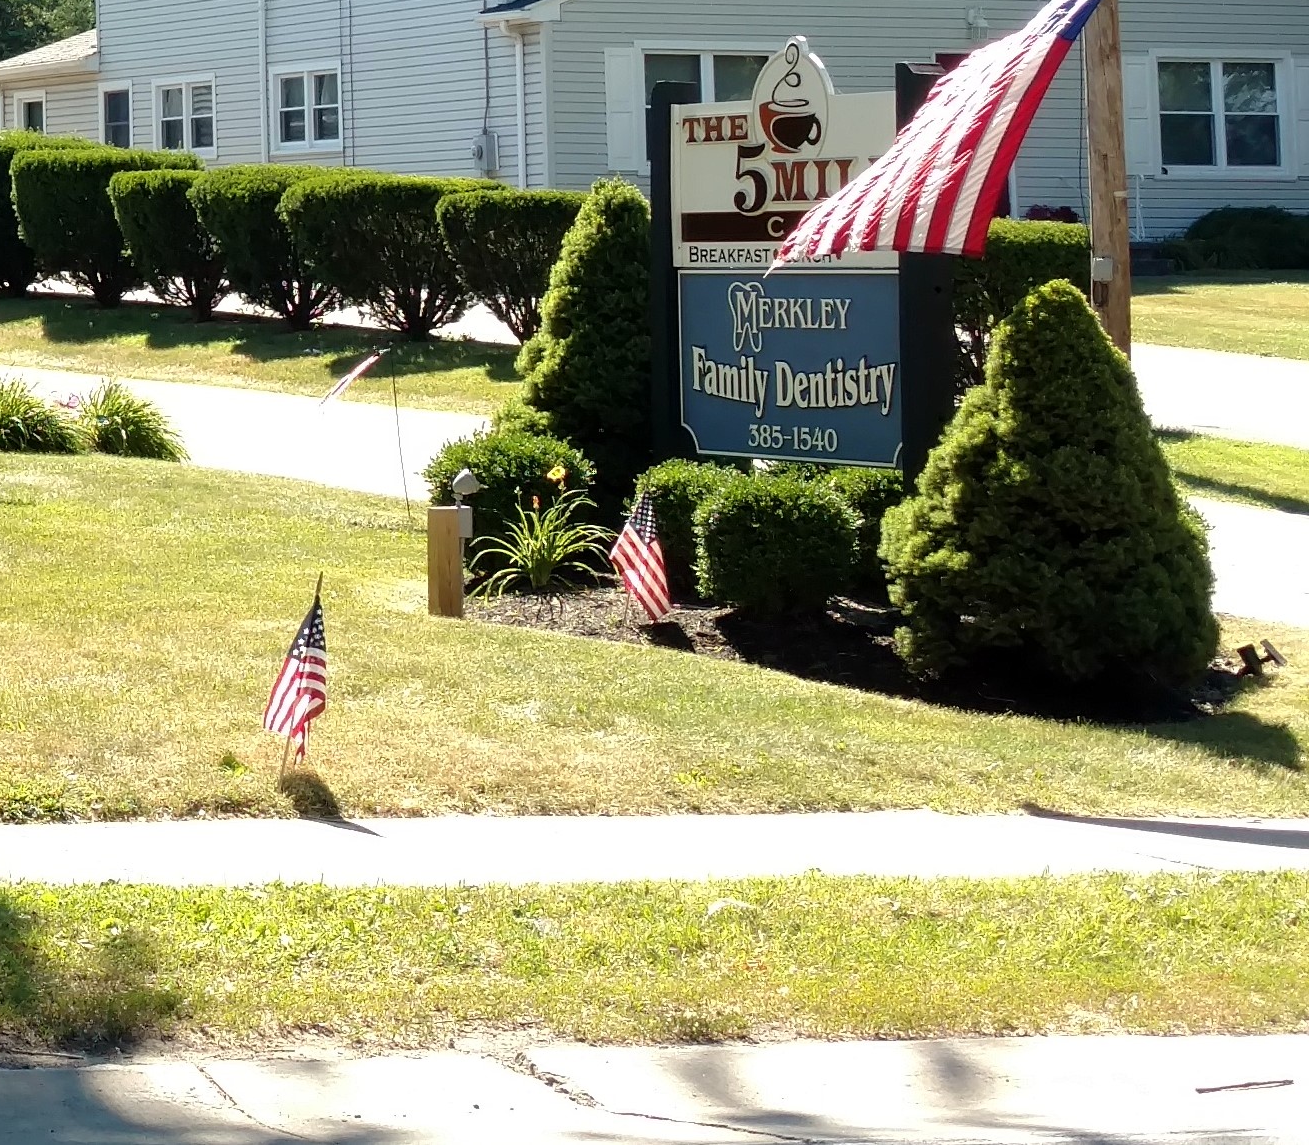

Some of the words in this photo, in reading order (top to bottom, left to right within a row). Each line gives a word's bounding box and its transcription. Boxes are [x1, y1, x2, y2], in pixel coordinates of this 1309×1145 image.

[682, 114, 748, 143] THE
[733, 143, 768, 214] 5
[771, 157, 885, 202] MIL
[689, 245, 769, 263] BREAKFAST
[734, 291, 851, 334] MERKLEY
[692, 345, 769, 418] Family
[775, 356, 896, 416] Dentistry
[747, 424, 838, 452] 385-1540
